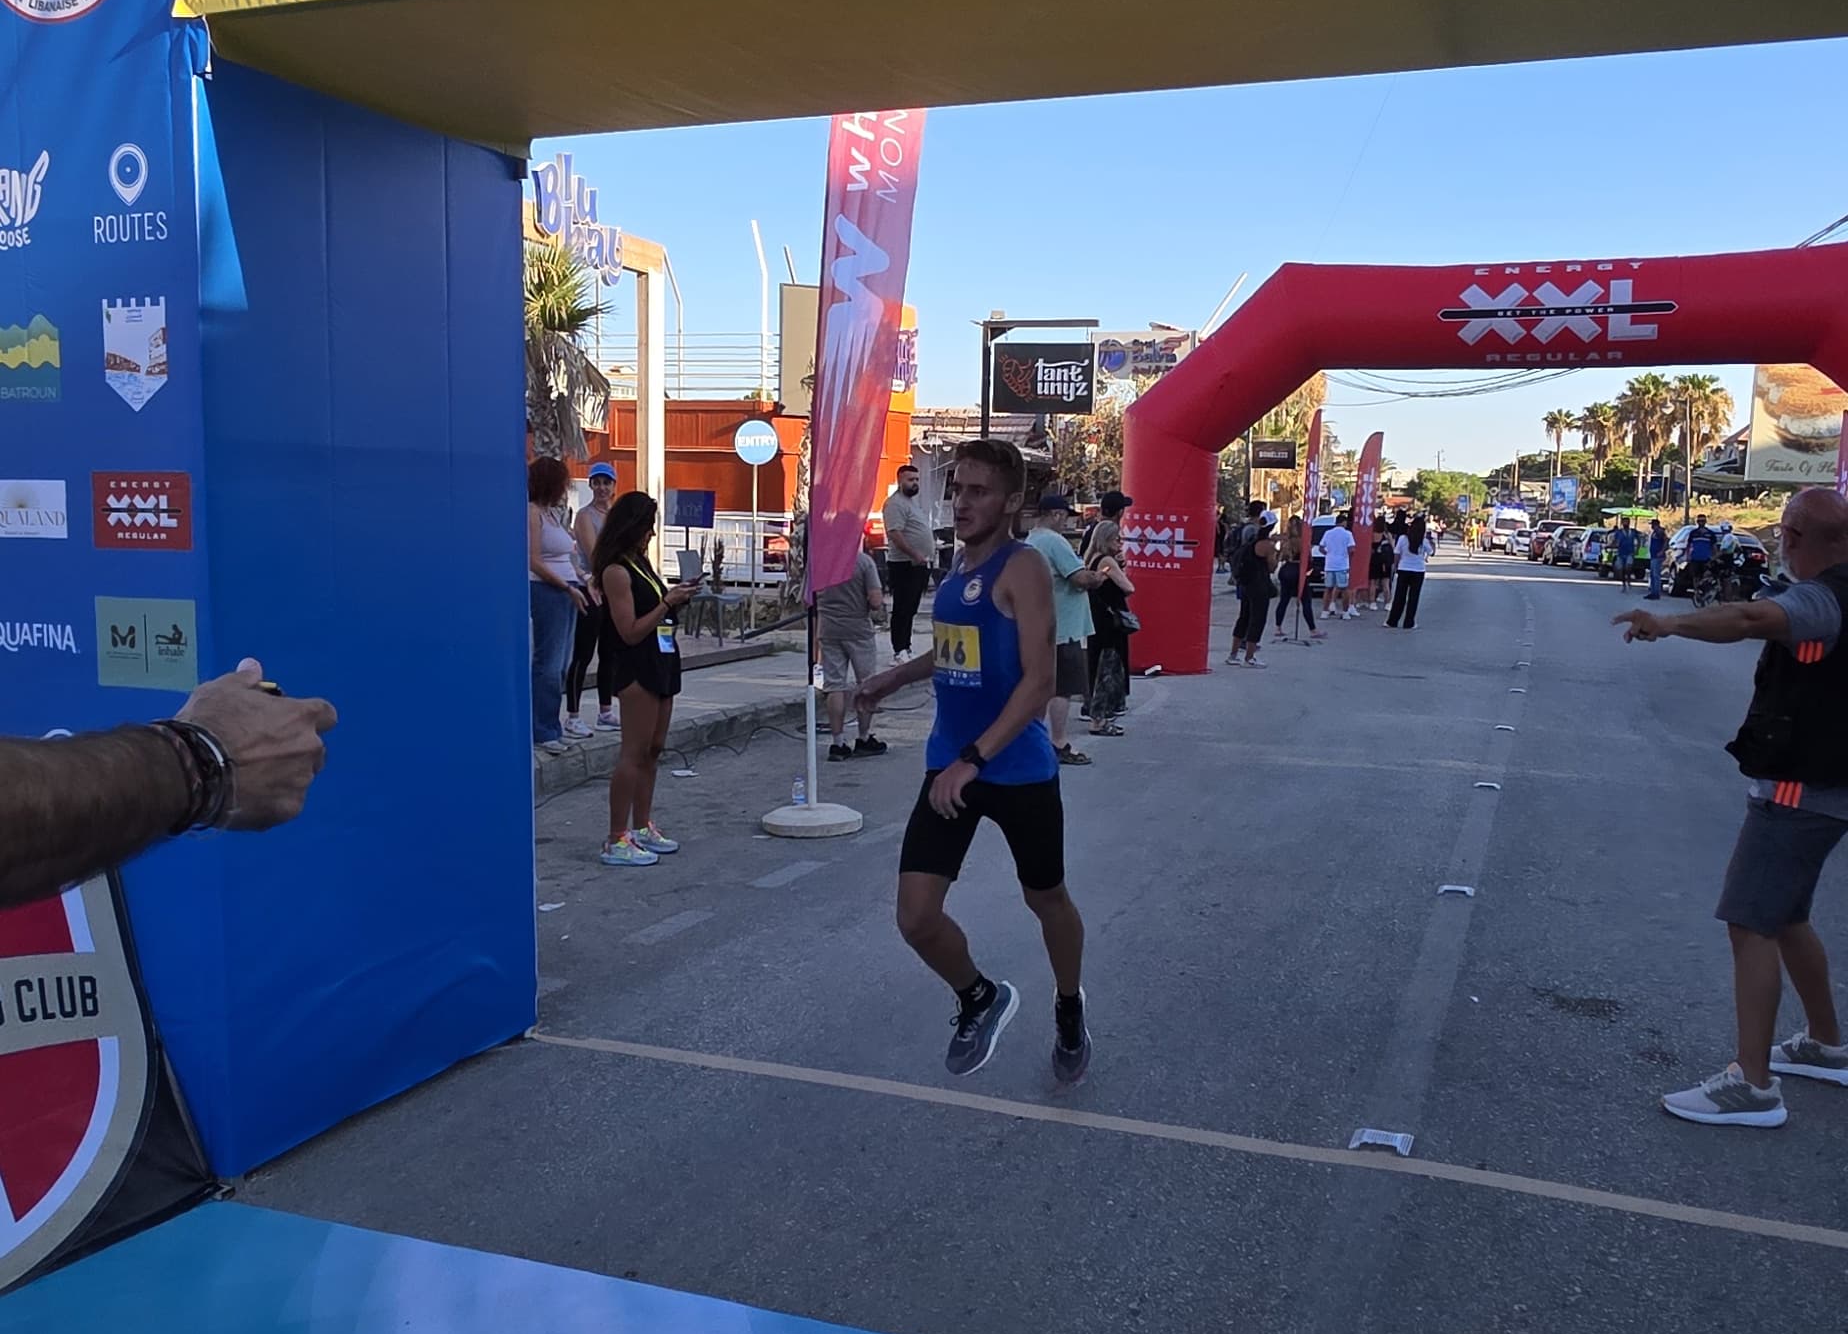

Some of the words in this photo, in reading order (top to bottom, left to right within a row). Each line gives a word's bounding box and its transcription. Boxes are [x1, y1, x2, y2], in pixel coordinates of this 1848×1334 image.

[532, 152, 599, 236] Blu
[94, 211, 168, 244] ROUTES
[1474, 261, 1643, 276] ENERGY
[1457, 278, 1659, 347] XXL
[1565, 307, 1615, 315] POWER
[1485, 351, 1623, 363] REGULAR
[0, 386, 57, 400] BATROUN
[738, 435, 776, 447] ENTRY
[109, 481, 171, 489] ENERGY
[106, 494, 178, 527] XXL
[117, 532, 167, 540] REGULAR
[1123, 525, 1194, 559] XXL
[14, 975, 98, 1023] CLUB
